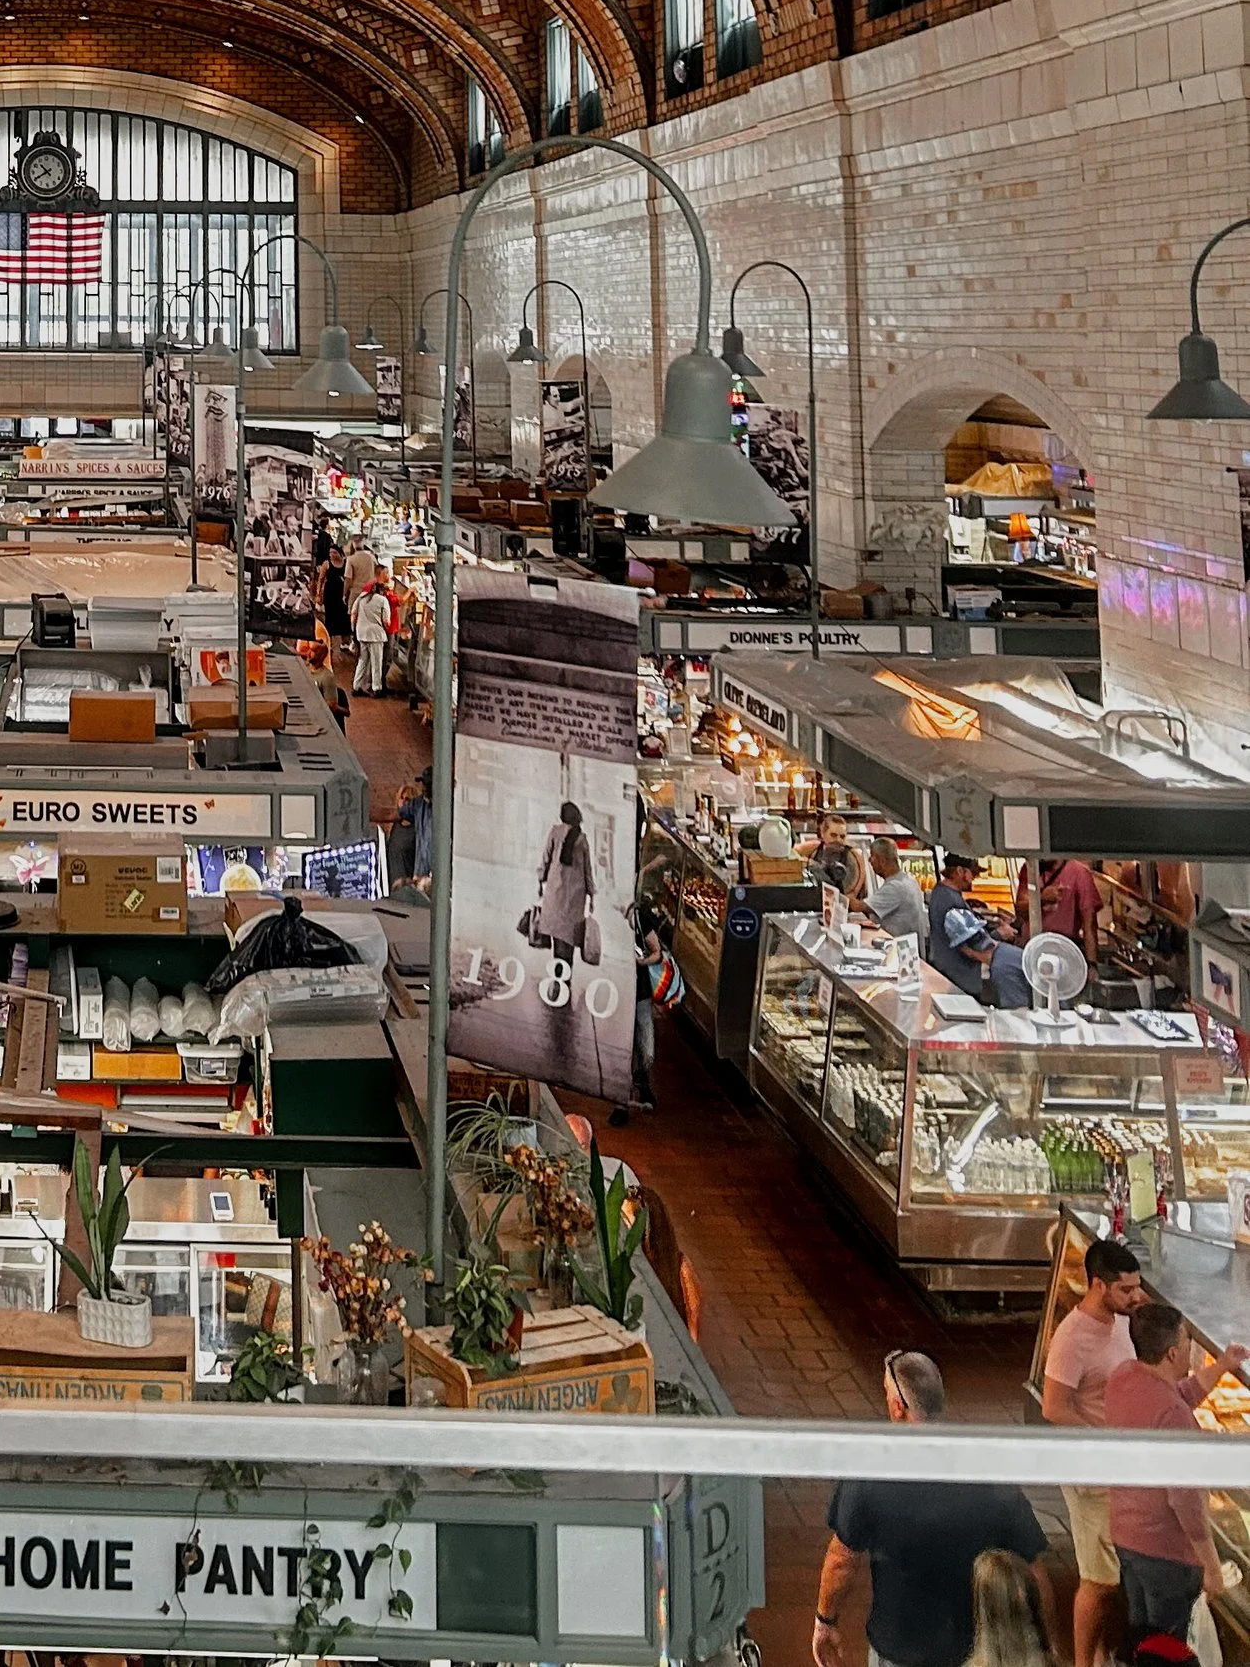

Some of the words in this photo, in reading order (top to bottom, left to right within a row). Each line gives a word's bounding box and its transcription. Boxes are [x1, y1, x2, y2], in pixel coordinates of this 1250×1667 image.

[76, 462, 110, 474] SPICES
[114, 463, 121, 474] &
[126, 462, 165, 474] SAUCES
[201, 485, 231, 500] 1976
[254, 584, 303, 612] 1977
[729, 631, 793, 645] DIONNE'S
[562, 697, 573, 706] TO
[587, 722, 593, 730] A
[12, 800, 81, 823] EURO
[91, 802, 198, 825] SWEETS
[461, 947, 619, 1019] 1980
[702, 1501, 730, 1560] D
[175, 1542, 377, 1601] PANTRY
[709, 1570, 727, 1622] 2
